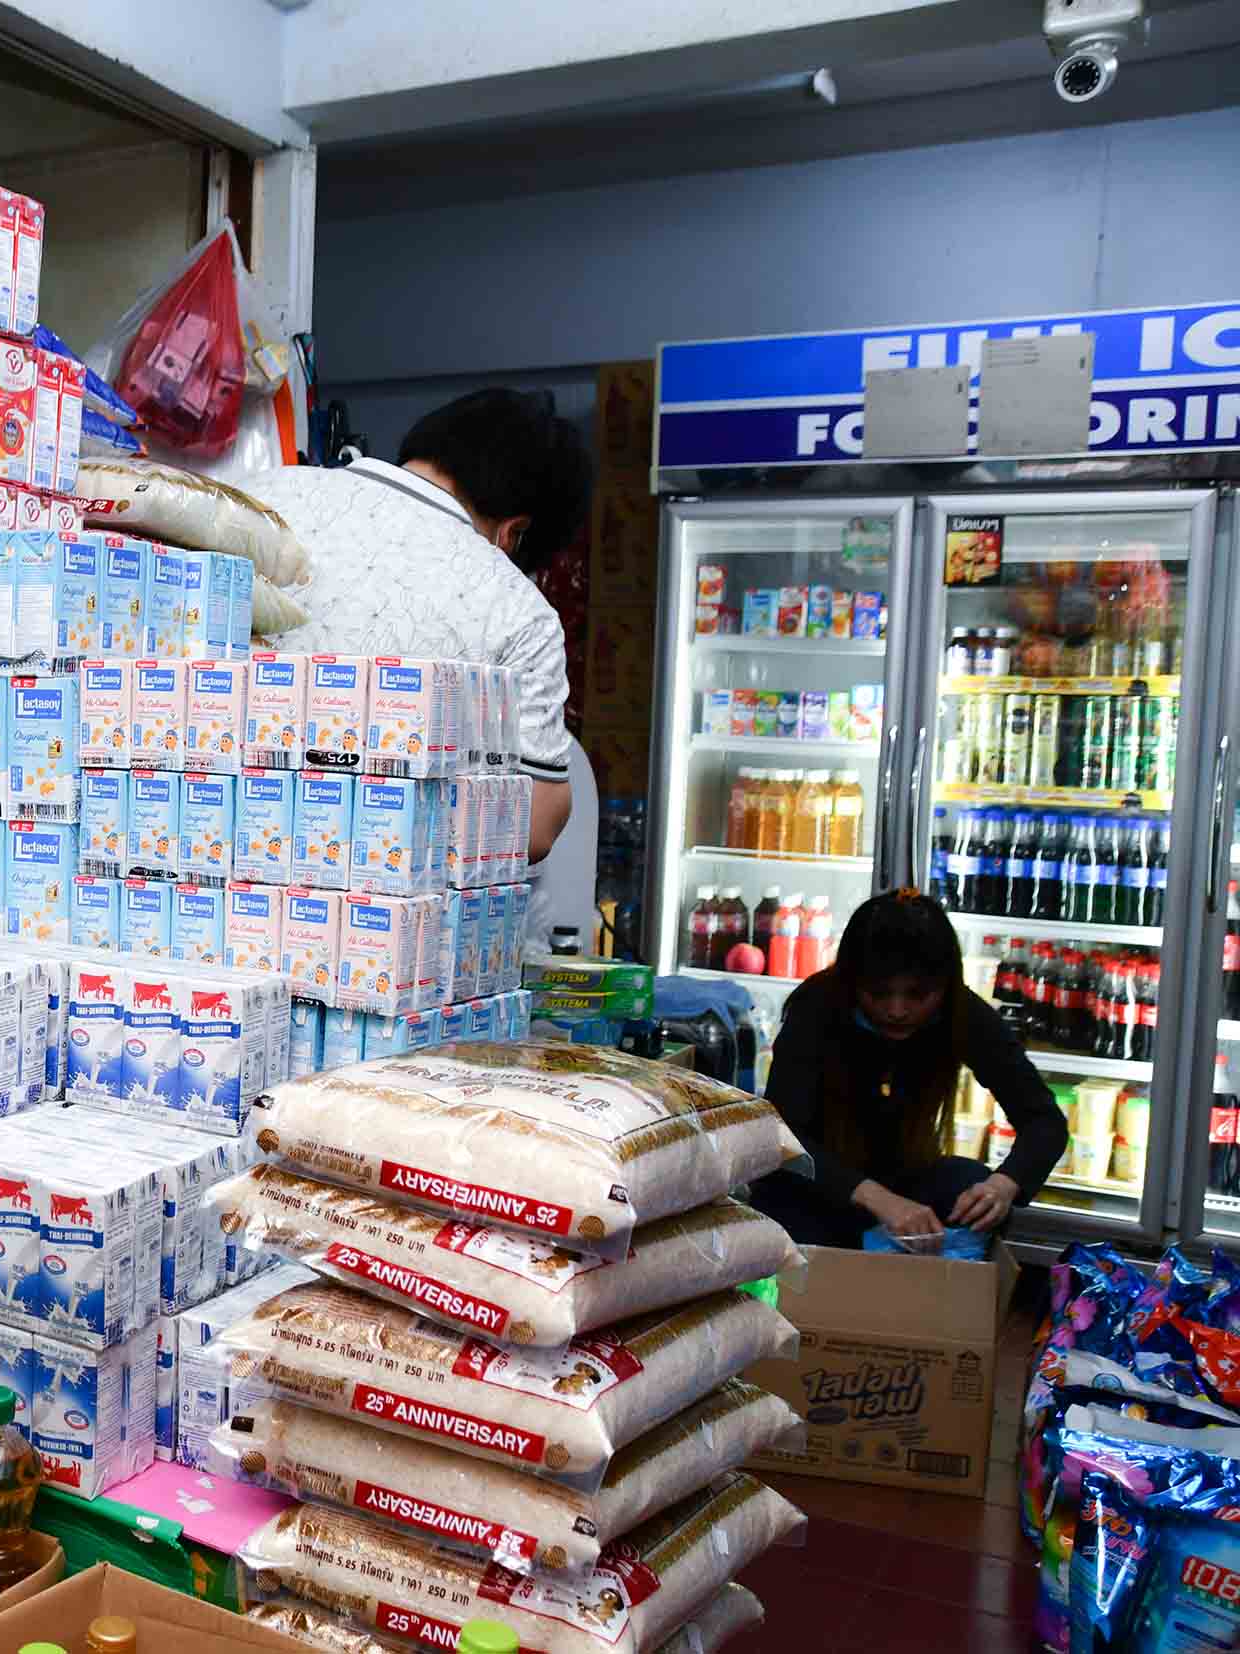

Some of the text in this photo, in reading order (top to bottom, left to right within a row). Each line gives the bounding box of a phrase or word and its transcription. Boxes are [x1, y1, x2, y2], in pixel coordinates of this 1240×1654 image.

[17, 690, 61, 716] Lactasoy
[15, 834, 58, 859] Lactasoy
[76, 1006, 115, 1016] THAI-DENMARK
[133, 1014, 172, 1025] THAI-DENMARK
[189, 1024, 232, 1035] THAI-DENMARK
[392, 1168, 559, 1227] 25th ANNIVERSARY
[49, 1229, 94, 1242] THAI-DENMARK
[386, 1230, 403, 1245] 250
[408, 1238, 425, 1254] บาท
[368, 1257, 501, 1329] ANNIVERSARY
[316, 1338, 336, 1353] 5.25
[339, 1340, 375, 1363] กิโลกรัม
[379, 1357, 400, 1372] ราคา
[404, 1362, 423, 1377] 250
[428, 1370, 446, 1385] บาท
[365, 1393, 530, 1455] 25th ANNIVERSARY
[366, 1489, 493, 1542] ANNIVERSARY
[336, 1556, 357, 1571] 5.25
[359, 1560, 394, 1583] กิโลกรัม
[400, 1576, 422, 1592] ราคา
[427, 1583, 446, 1599] 250
[452, 1591, 470, 1606] บาท
[387, 1611, 420, 1631] 25th
